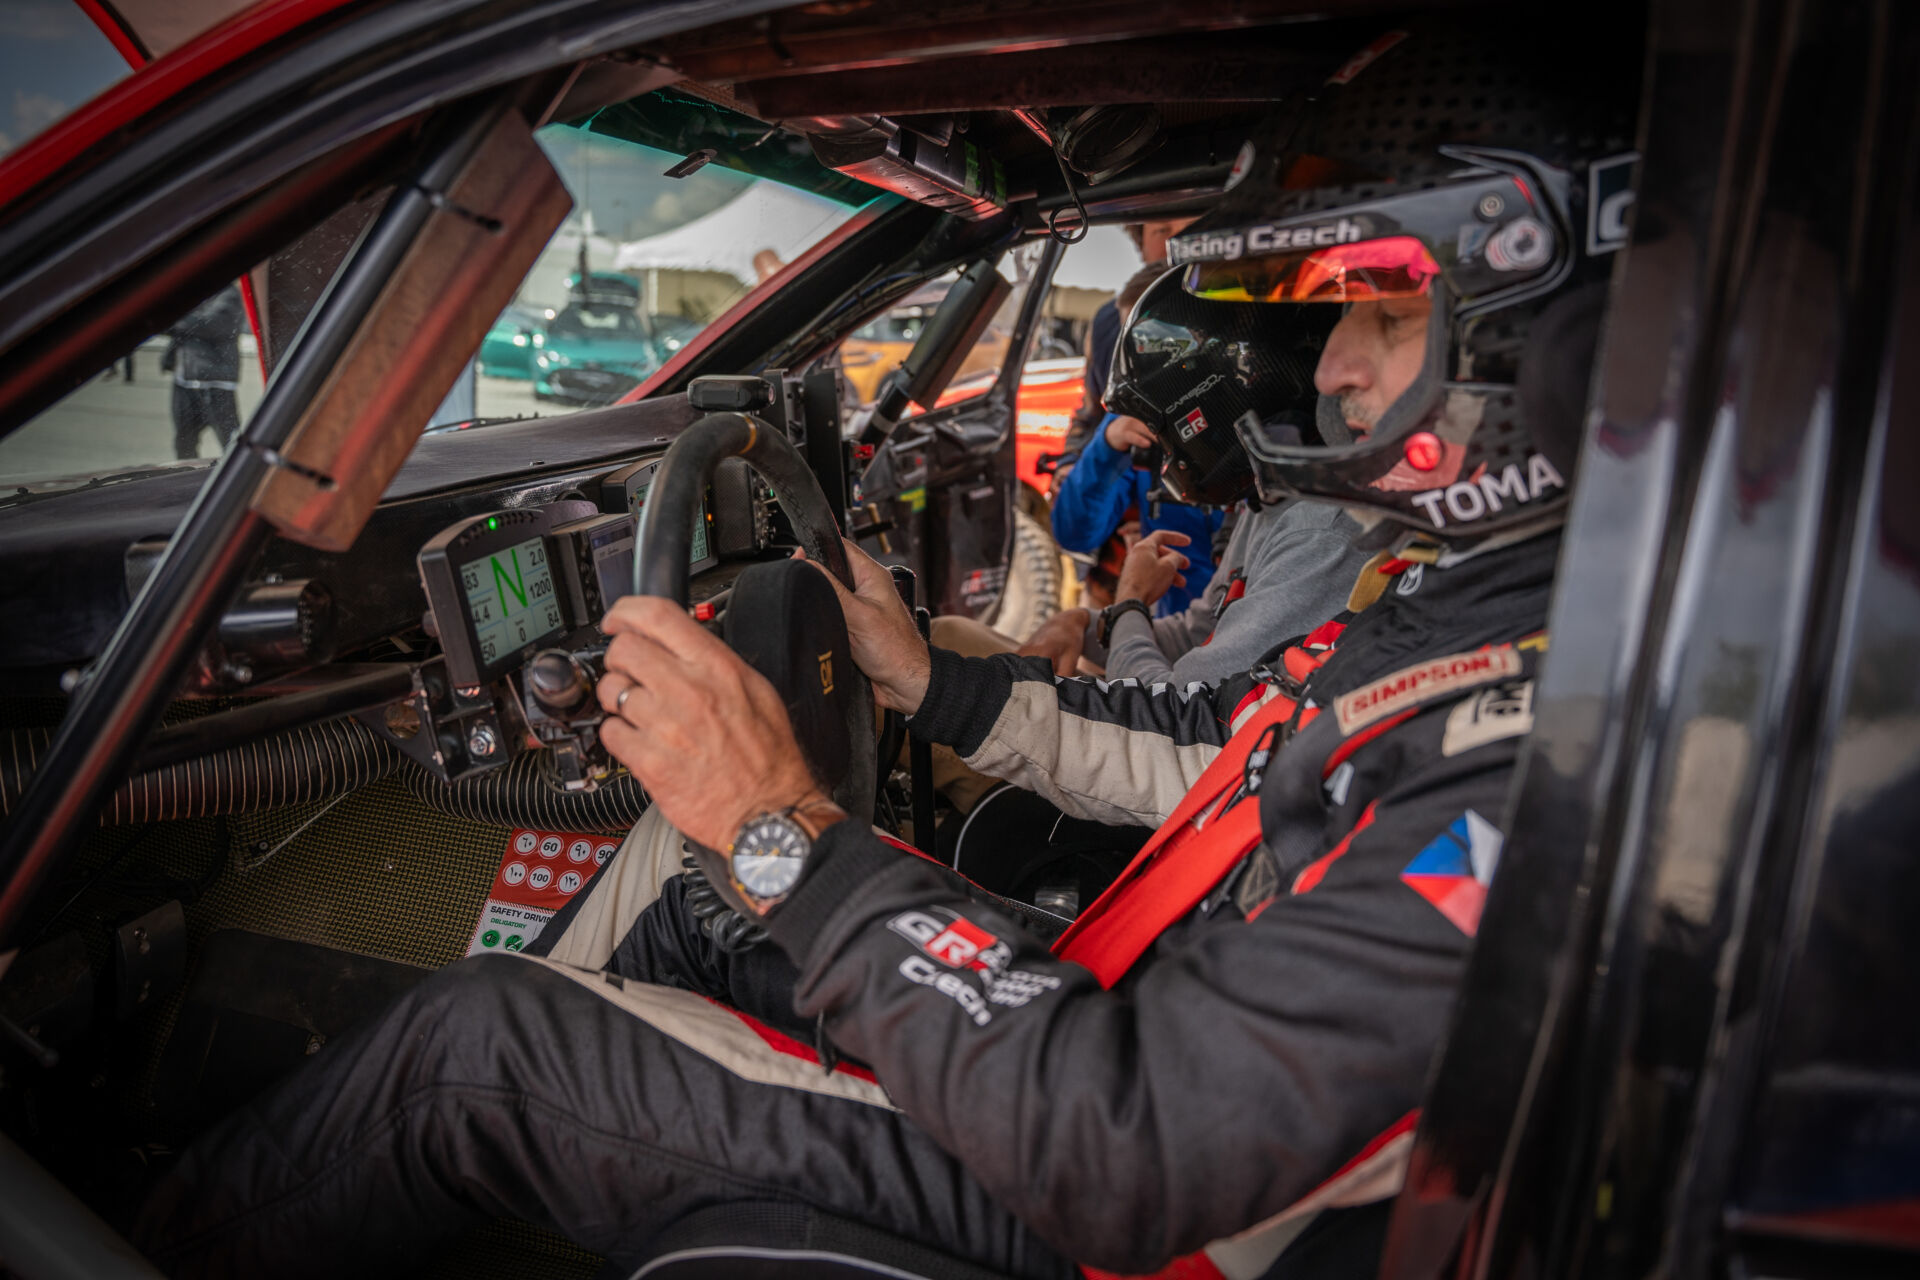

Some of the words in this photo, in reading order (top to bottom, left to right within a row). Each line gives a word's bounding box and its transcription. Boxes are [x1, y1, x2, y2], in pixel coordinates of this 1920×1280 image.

[1247, 219, 1362, 250] Czech
[529, 548, 545, 567] 2.0
[490, 548, 529, 617] N
[529, 577, 552, 599] 1200
[547, 610, 560, 628] 84
[519, 627, 527, 642] 0
[1352, 656, 1491, 714] SIMPSON
[543, 841, 558, 853] 60
[597, 849, 612, 860] 90
[532, 872, 549, 883] 100
[490, 906, 522, 918] SAFETY
[490, 917, 527, 929] OBLIGATORY
[895, 911, 978, 965] GR
